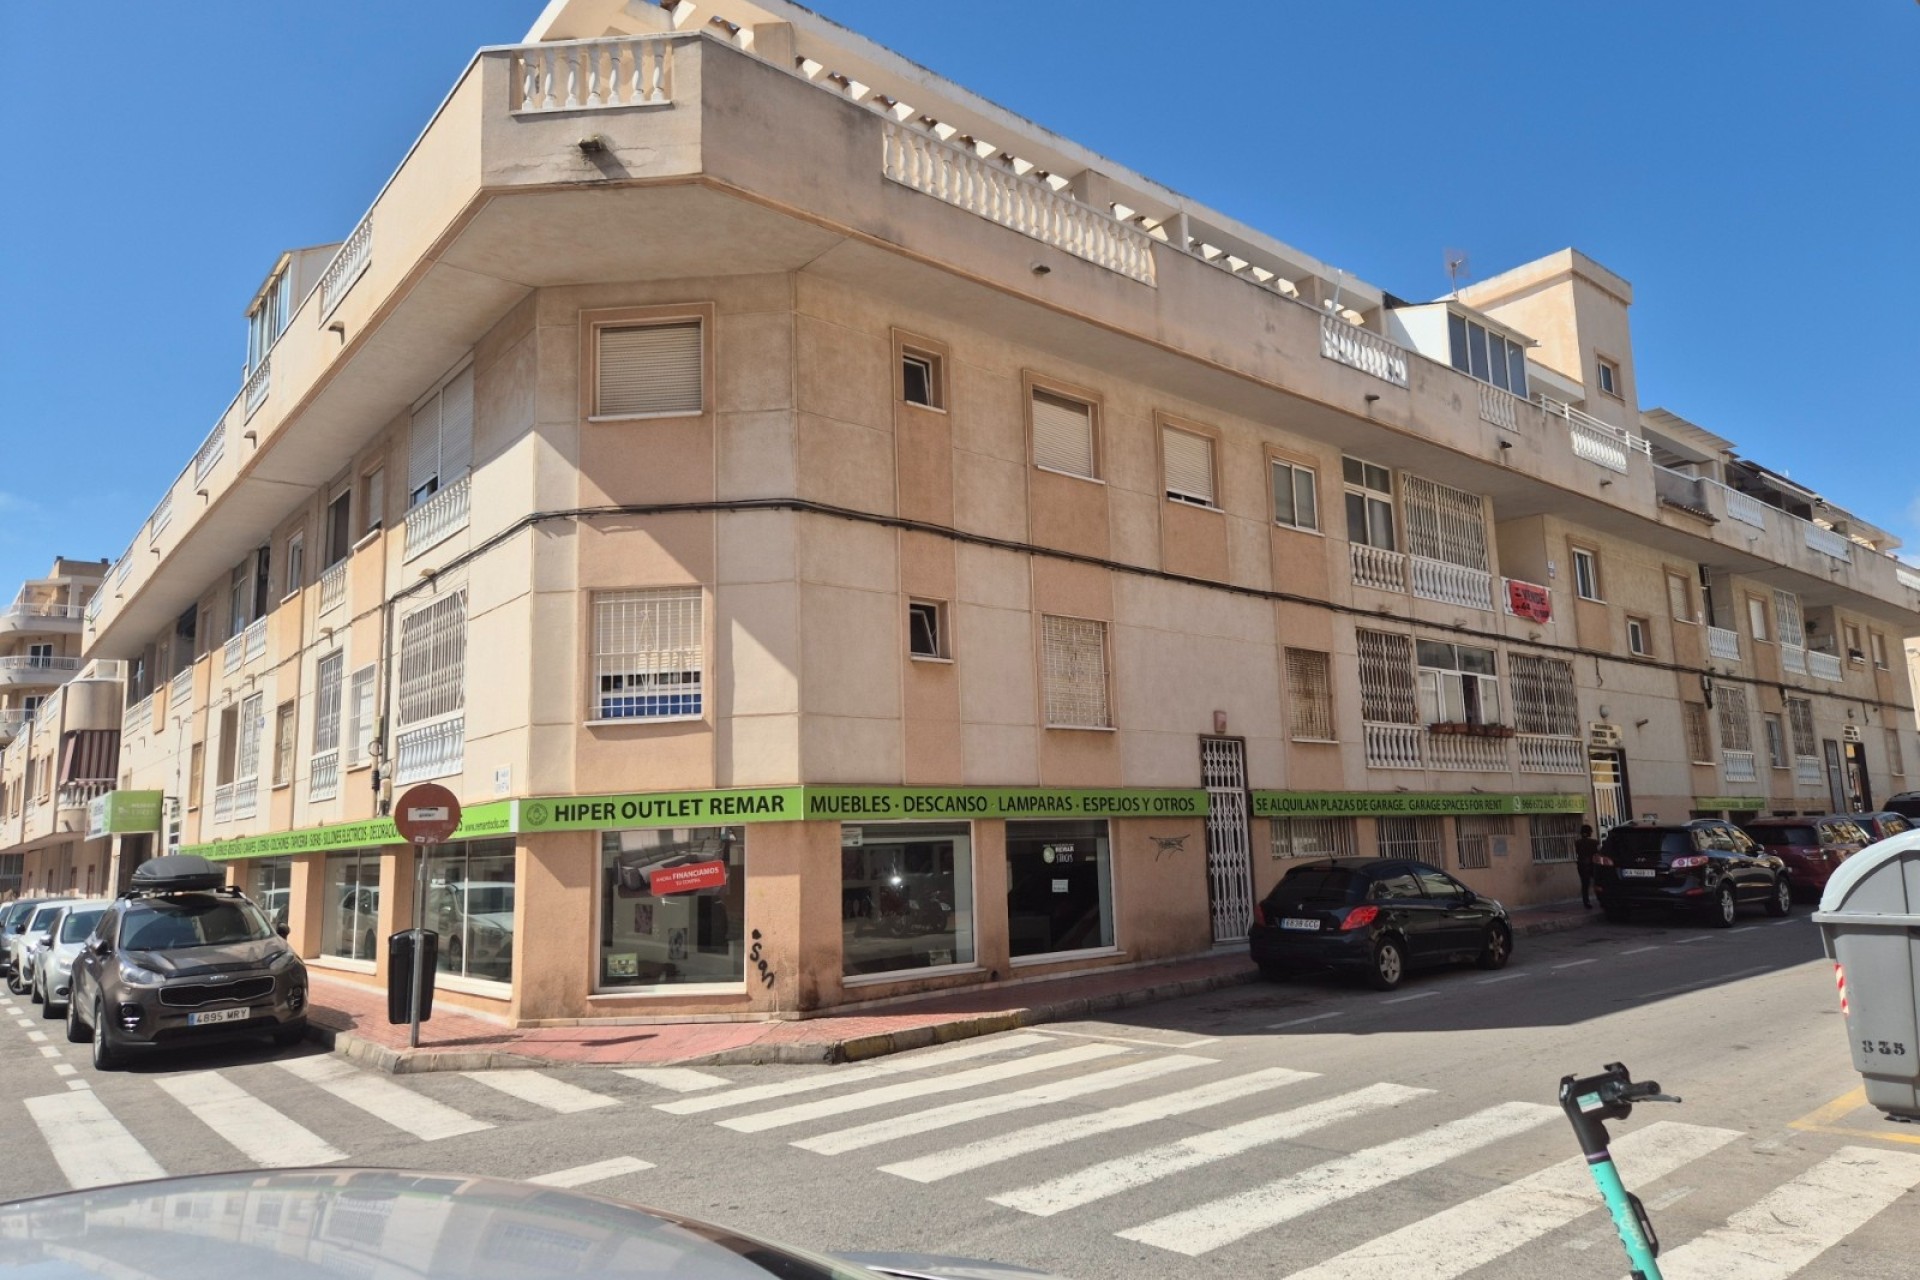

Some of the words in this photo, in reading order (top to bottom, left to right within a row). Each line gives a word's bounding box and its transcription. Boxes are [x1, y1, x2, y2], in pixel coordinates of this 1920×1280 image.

[554, 803, 616, 822] HIPER
[621, 799, 703, 819] OUTLET
[709, 796, 785, 815] REMAR
[810, 795, 891, 813] MUEBLES
[903, 795, 988, 812] DESCANSO
[998, 796, 1073, 812] LAMPARAS
[1083, 797, 1140, 812] ESPEJOS
[1140, 797, 1150, 811] Y
[1153, 797, 1195, 811] OTROS
[1256, 798, 1268, 811] SE
[1270, 798, 1320, 812] ALQUILAN
[1321, 799, 1356, 812] PLAZAS
[1357, 799, 1369, 811] DE
[1408, 799, 1441, 811] GARAGE
[1442, 799, 1469, 811] SPACES
[1469, 799, 1485, 811] FOR
[1486, 799, 1502, 811] RENT
[672, 866, 720, 880] FINANCIAMOS
[197, 1011, 223, 1024] 4895
